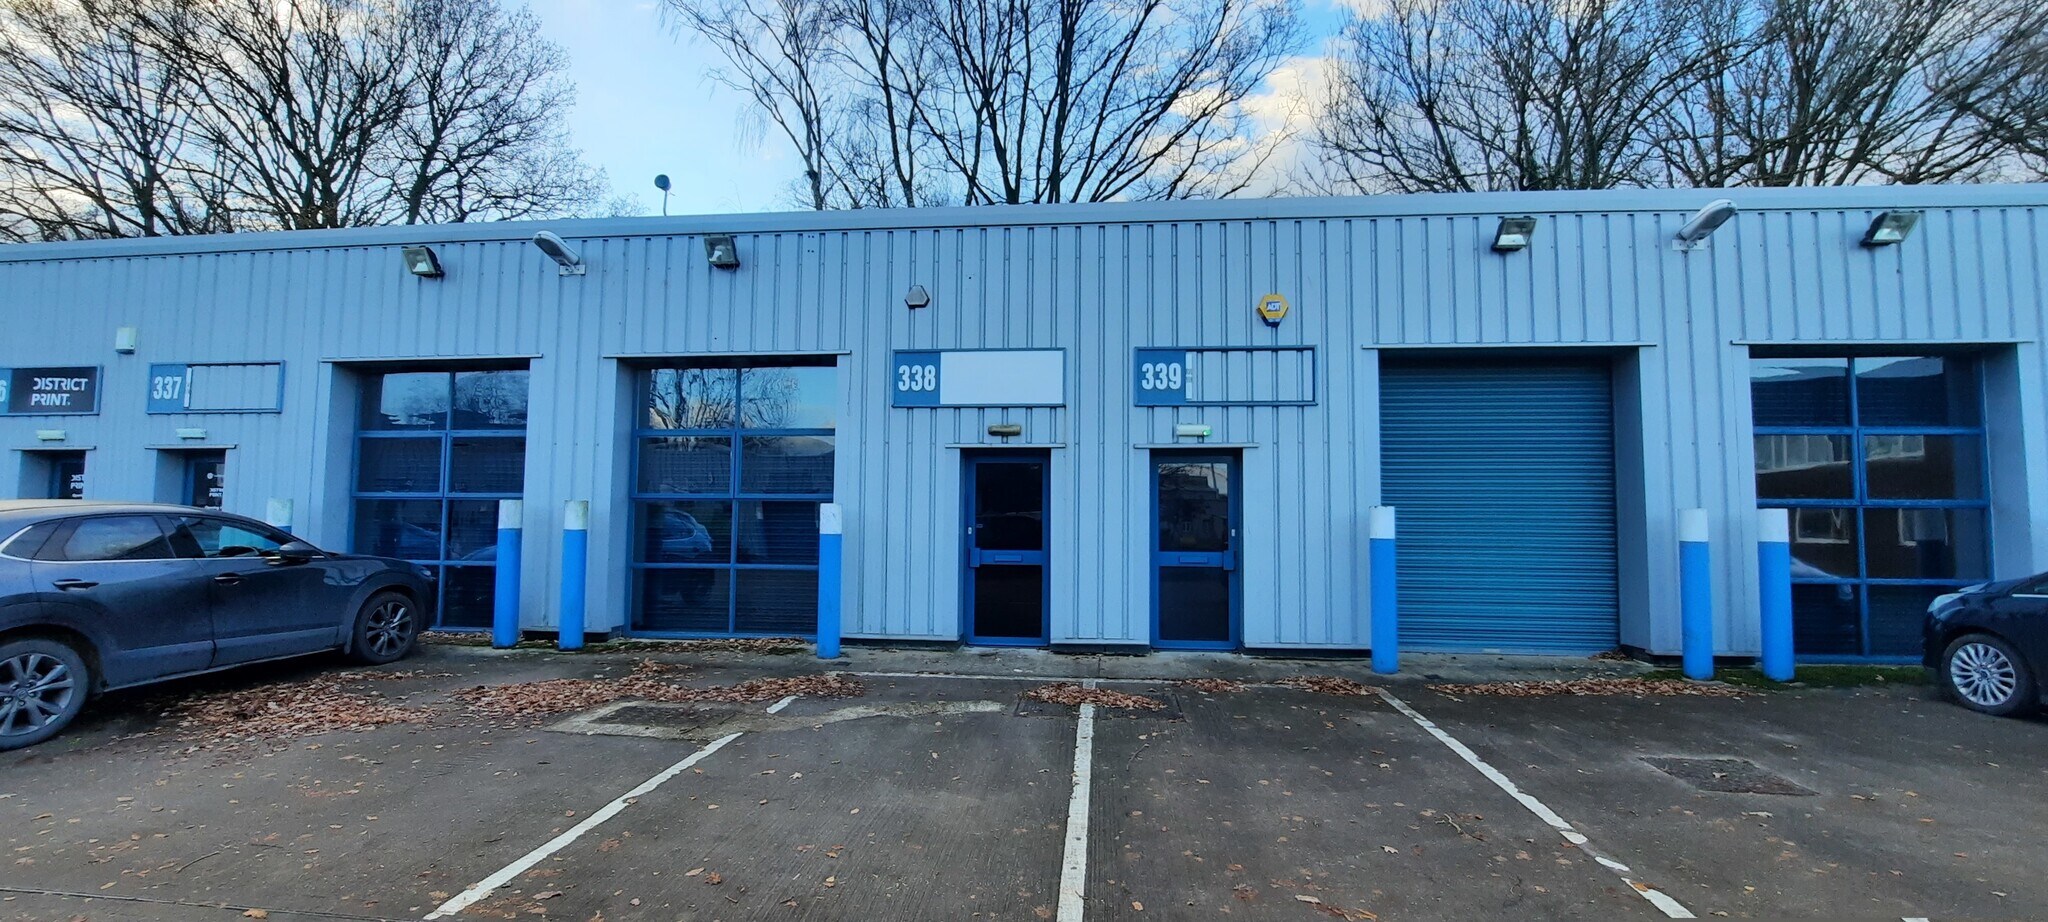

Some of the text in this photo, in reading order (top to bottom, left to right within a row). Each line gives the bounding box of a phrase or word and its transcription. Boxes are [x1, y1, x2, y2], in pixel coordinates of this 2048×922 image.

[33, 377, 88, 391] DISTRICT
[153, 376, 182, 400] 337
[898, 364, 936, 391] 338
[1141, 362, 1182, 390] 339
[31, 393, 71, 406] PRINT.
